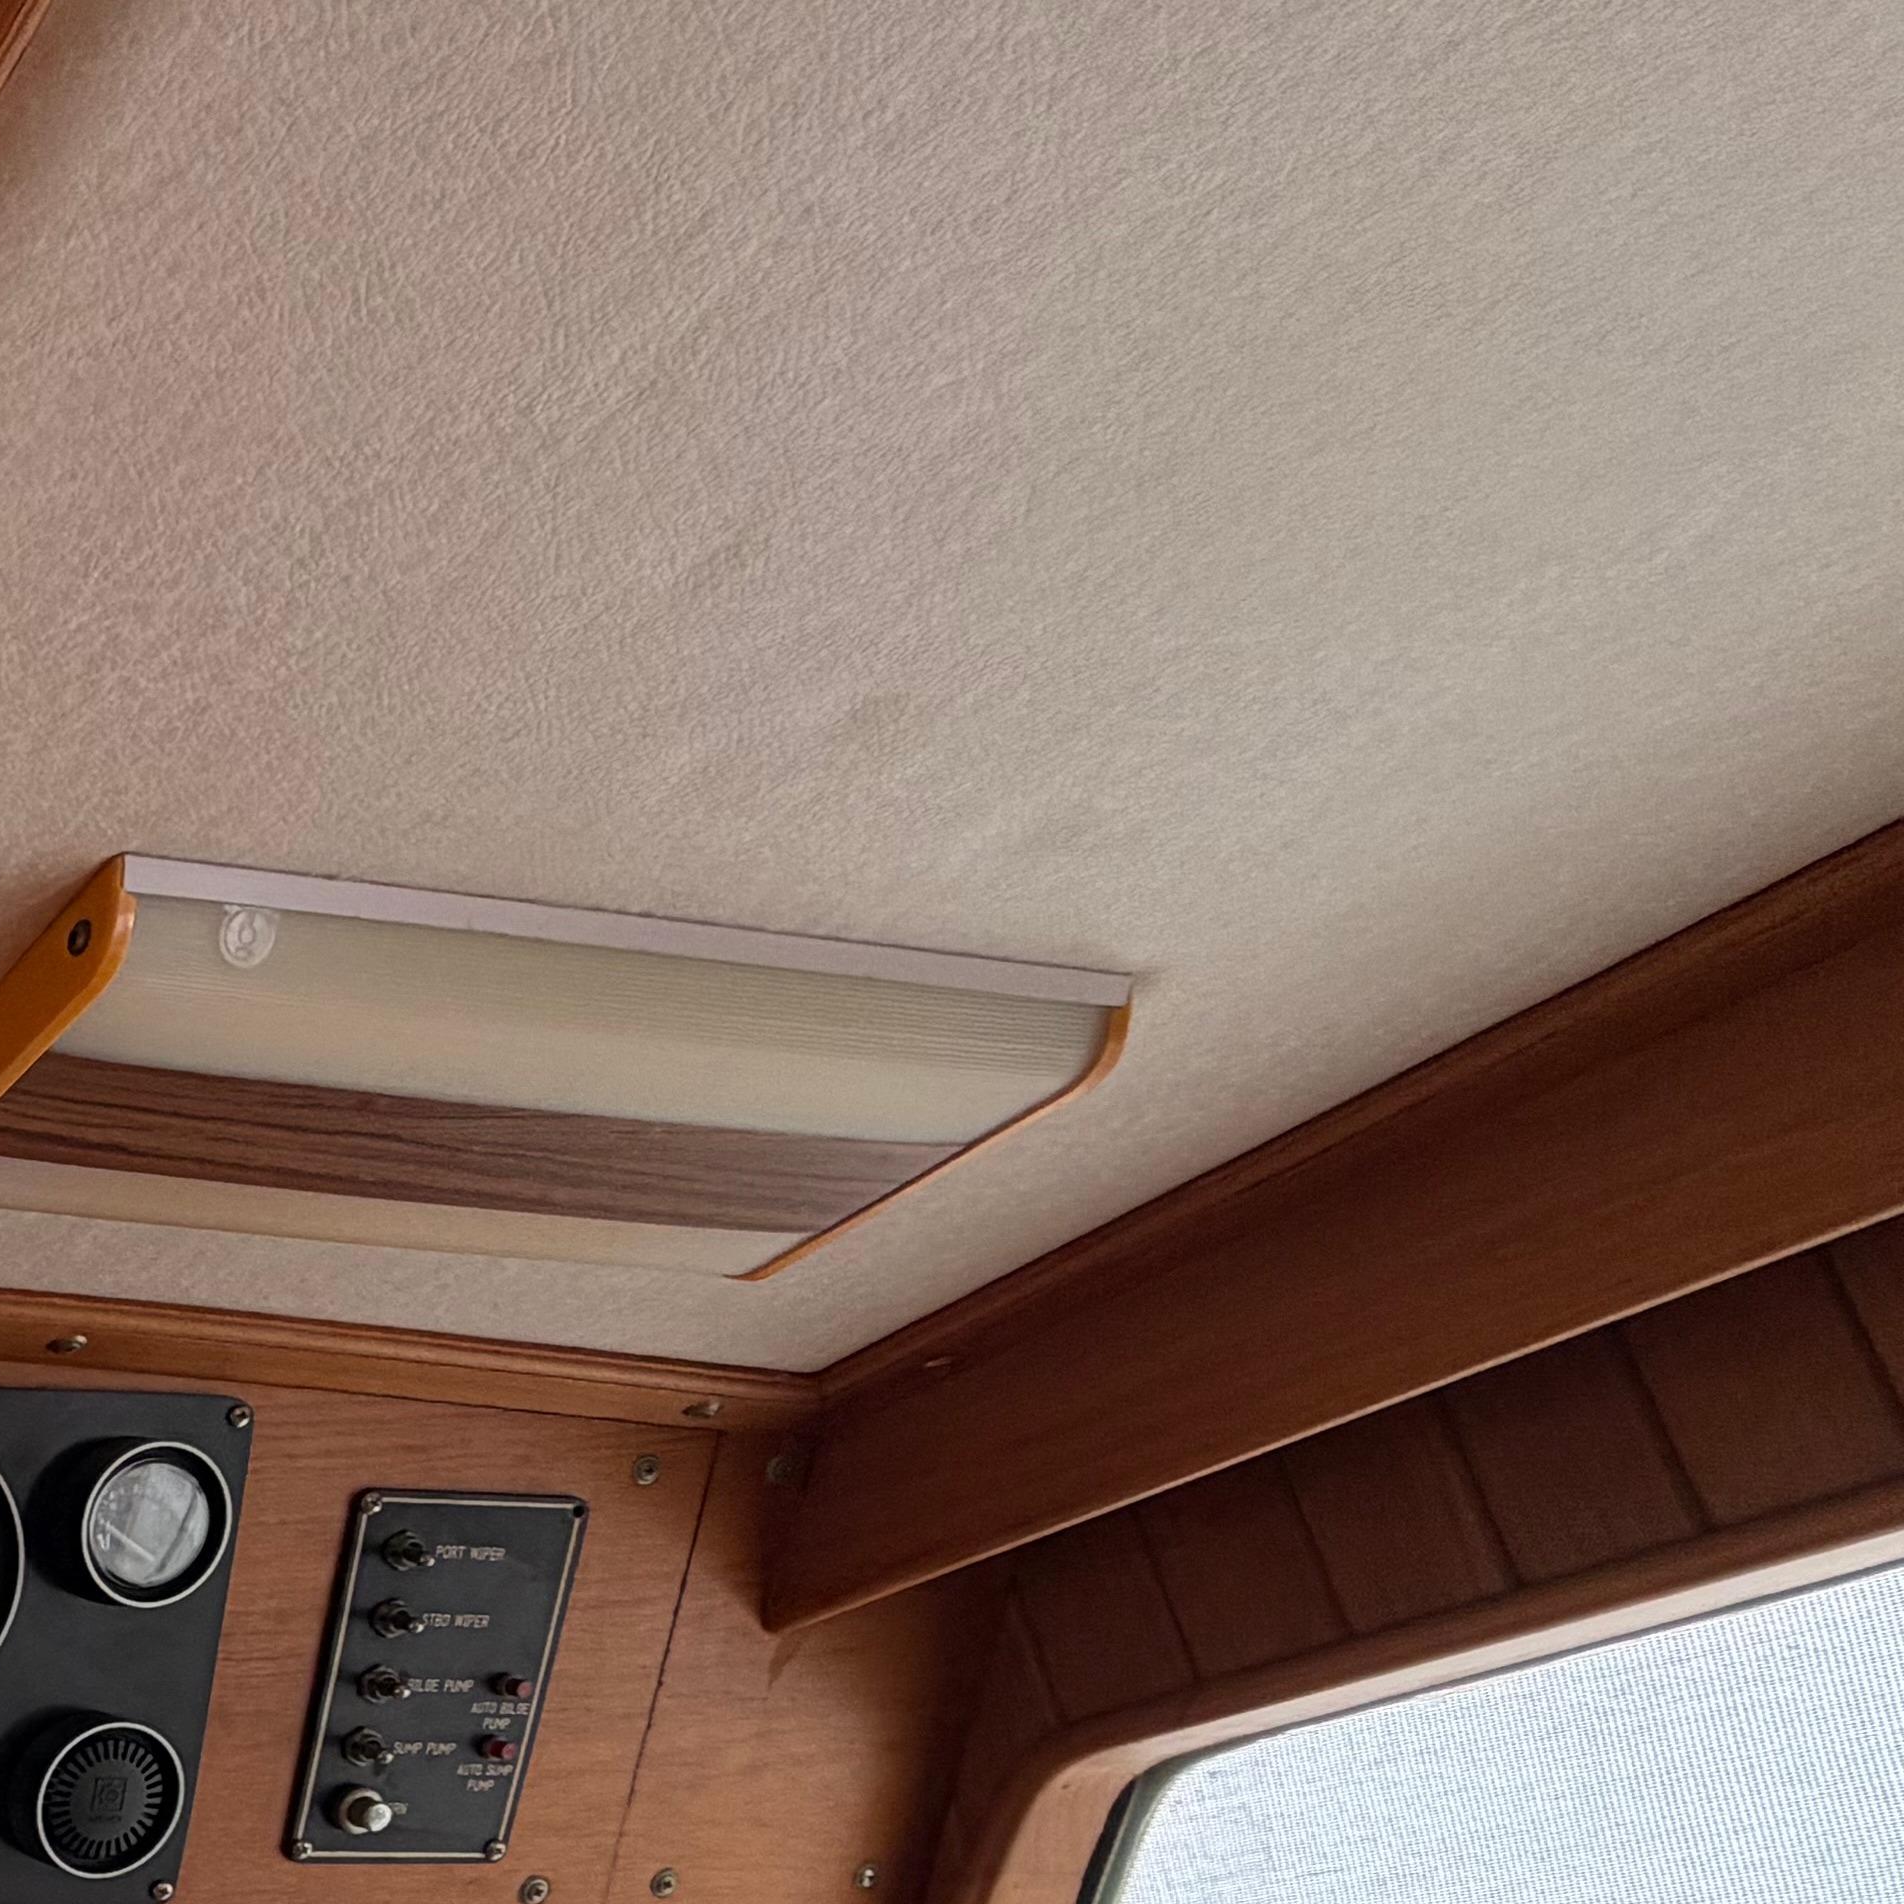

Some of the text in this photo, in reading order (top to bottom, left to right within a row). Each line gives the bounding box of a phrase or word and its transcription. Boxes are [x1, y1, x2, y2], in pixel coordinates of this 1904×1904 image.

[436, 1545, 506, 1561] PORT WIPER
[454, 1614, 490, 1628] WIPER
[443, 1679, 474, 1692] PUMP
[471, 1702, 498, 1714] AUTO
[482, 1717, 511, 1730] PUMP
[393, 1741, 457, 1755] SUMP PUMP
[467, 1779, 495, 1792] PUMP
